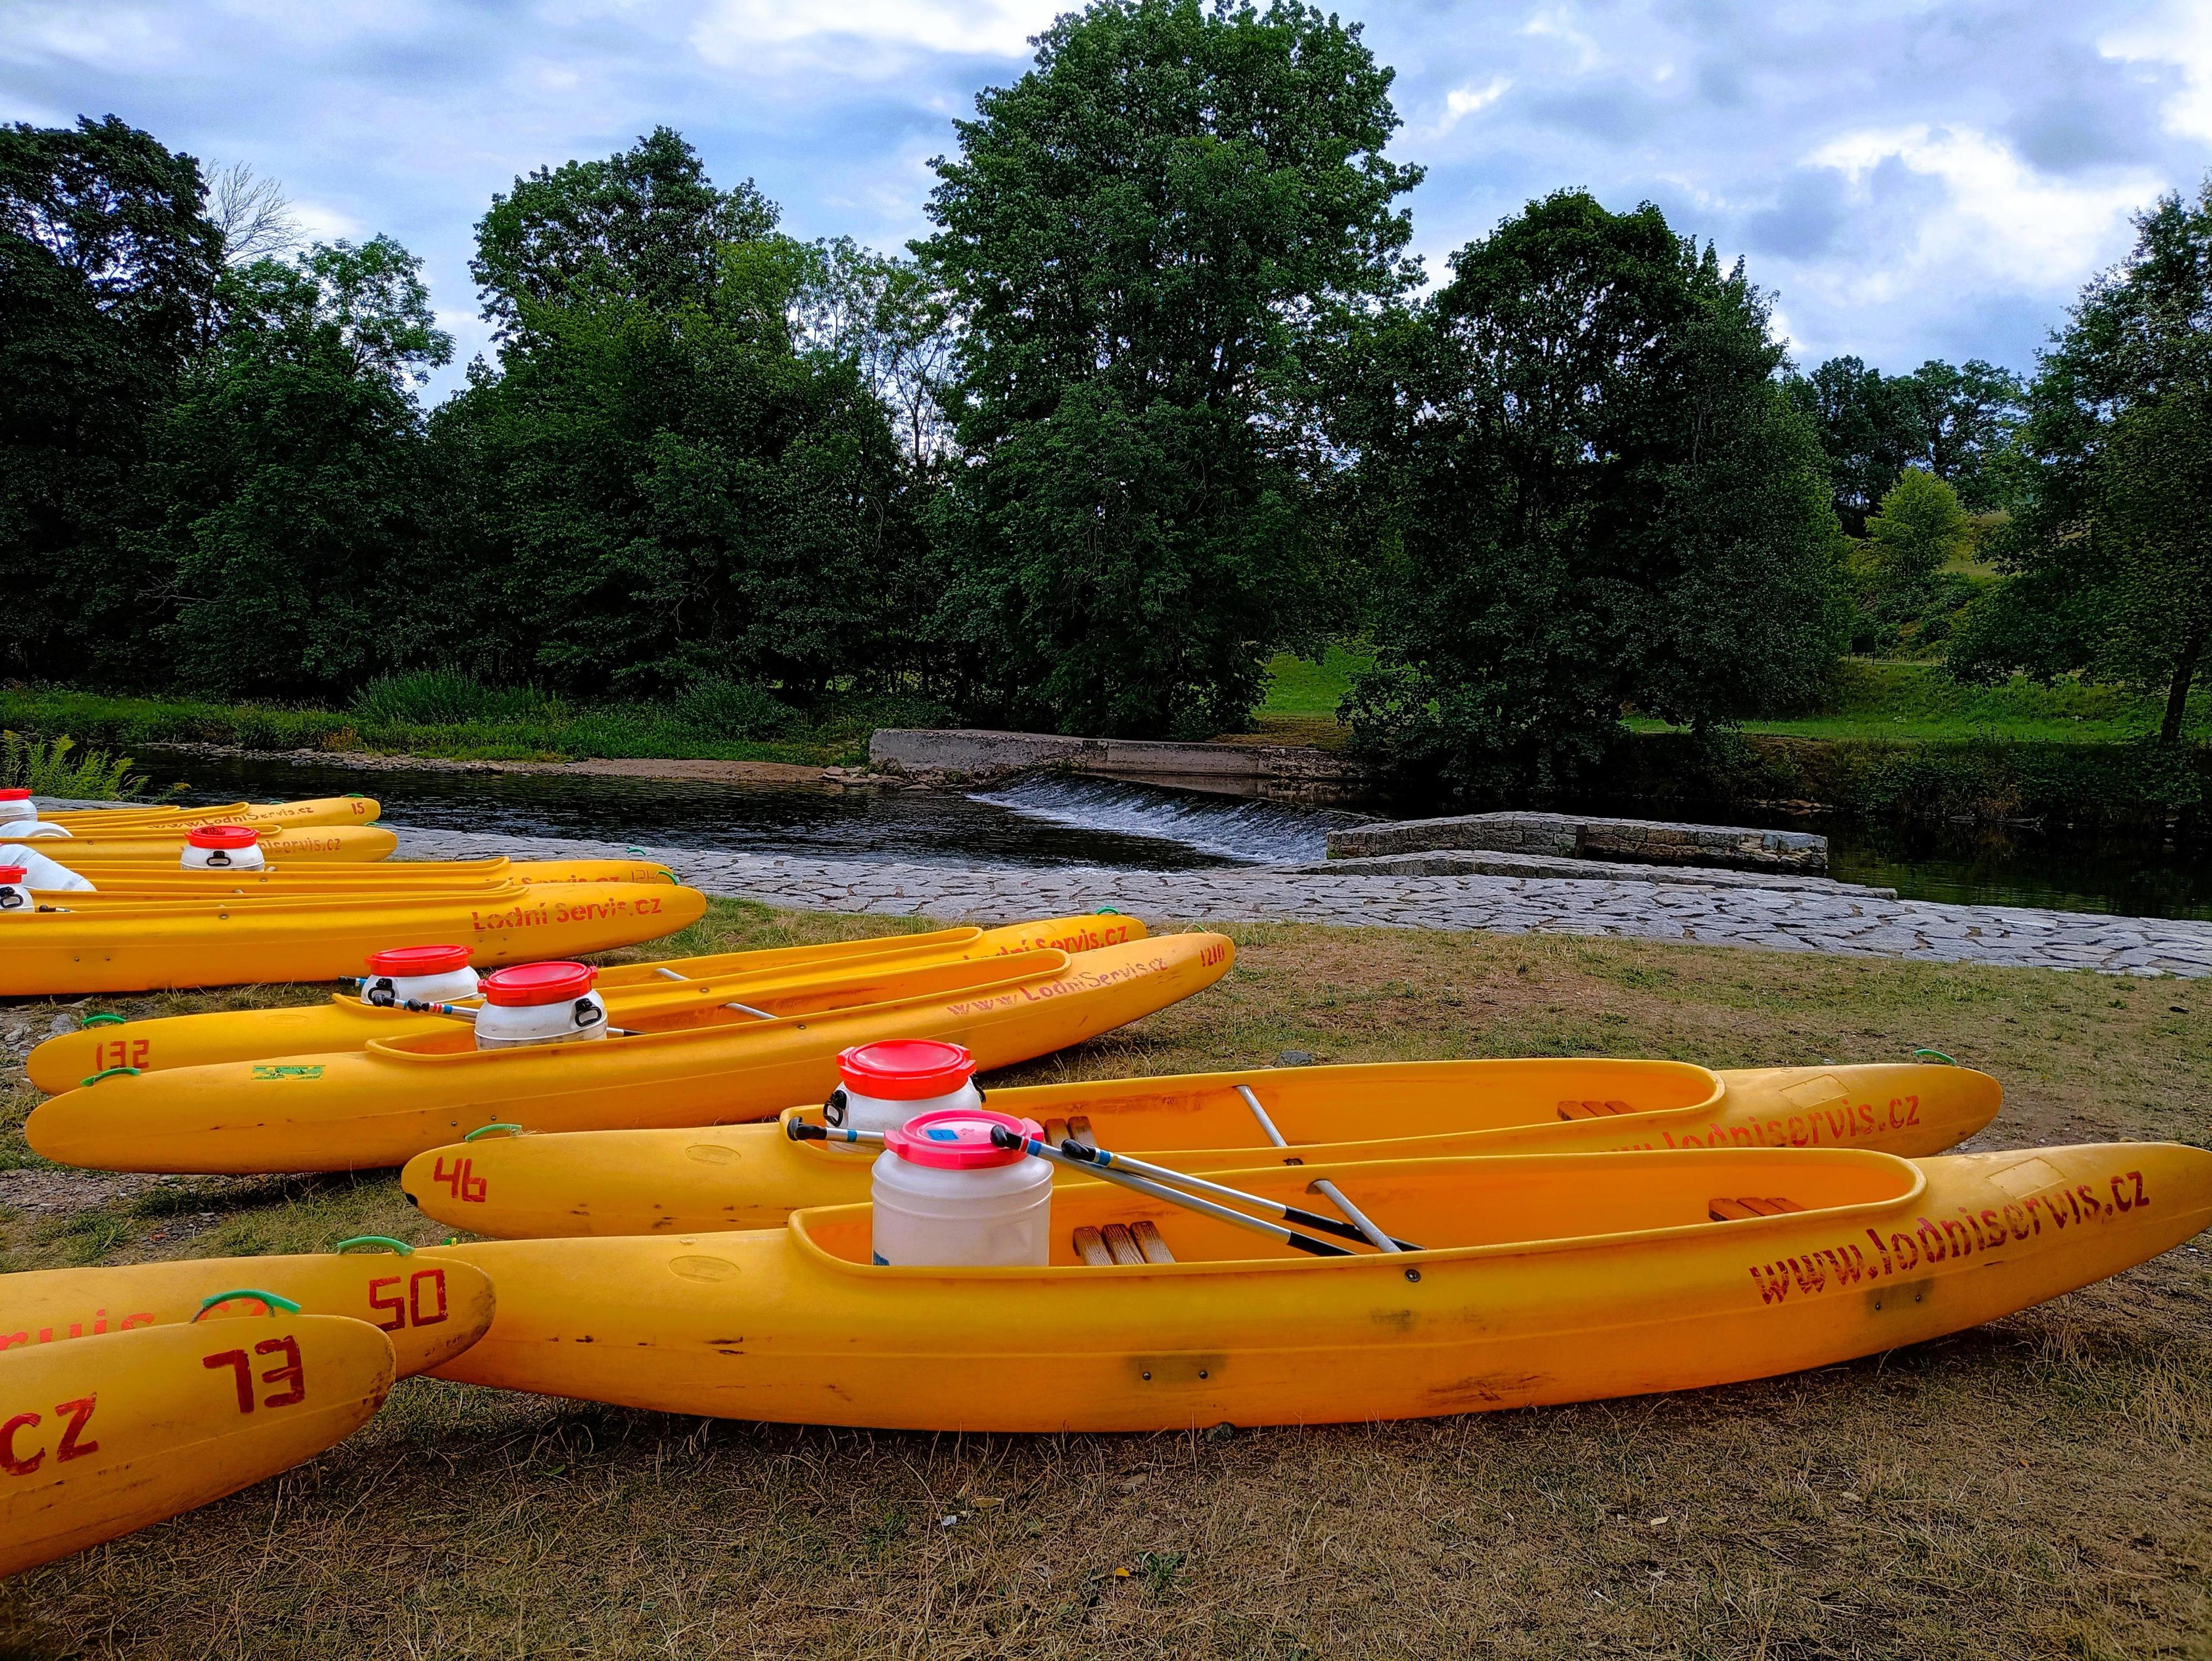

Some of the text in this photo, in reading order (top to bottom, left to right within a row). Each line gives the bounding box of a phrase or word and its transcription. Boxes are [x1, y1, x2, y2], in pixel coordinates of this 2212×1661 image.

[351, 802, 365, 815] 15
[96, 1040, 150, 1071] 132
[434, 1156, 487, 1203] 46
[1749, 1170, 2150, 1304] www.lodniservis.cz
[369, 1268, 448, 1332] 50
[203, 1335, 305, 1414] 73
